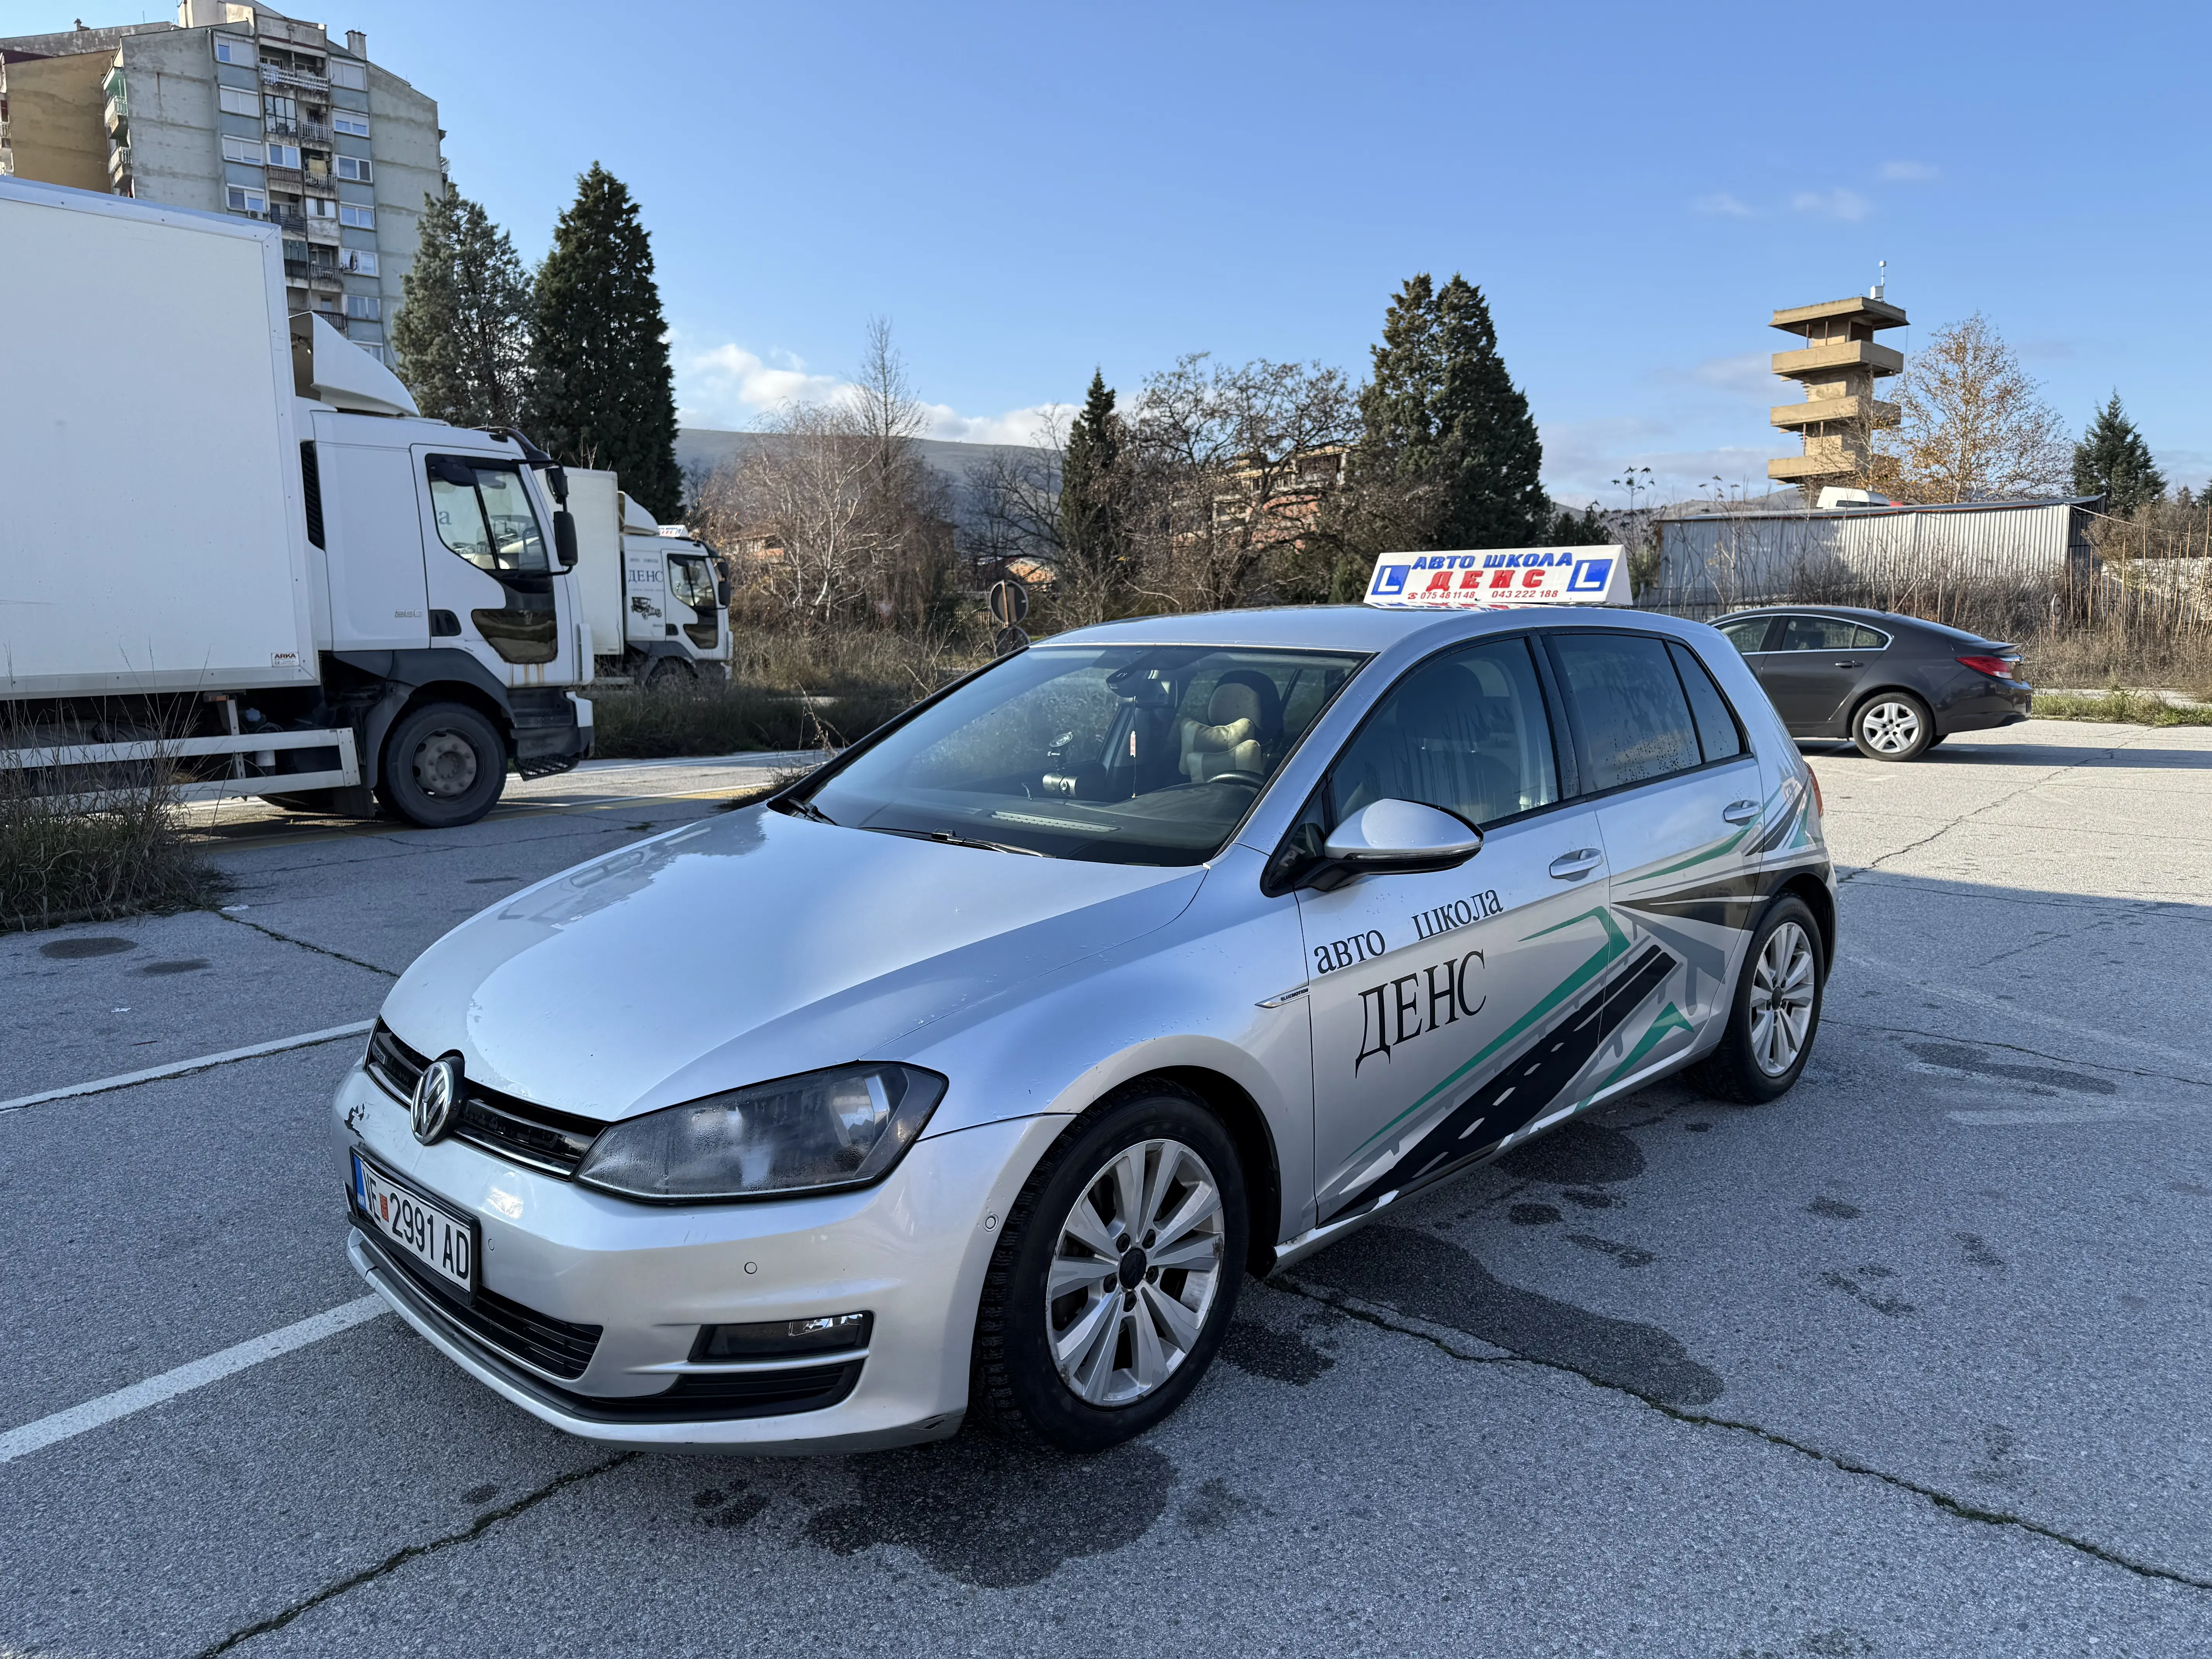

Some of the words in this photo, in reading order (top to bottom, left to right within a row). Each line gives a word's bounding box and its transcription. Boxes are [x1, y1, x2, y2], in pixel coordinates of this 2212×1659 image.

[1411, 555, 1475, 570] АВТО
[1483, 552, 1573, 568] ШКОЛА
[1426, 569, 1546, 592] ДЕНС
[1314, 929, 1386, 974] авто
[1411, 889, 1504, 941] школа
[1355, 948, 1487, 1079] ДЕНС
[362, 1168, 381, 1223] VE
[390, 1192, 434, 1261] 2991
[443, 1223, 469, 1279] AD
